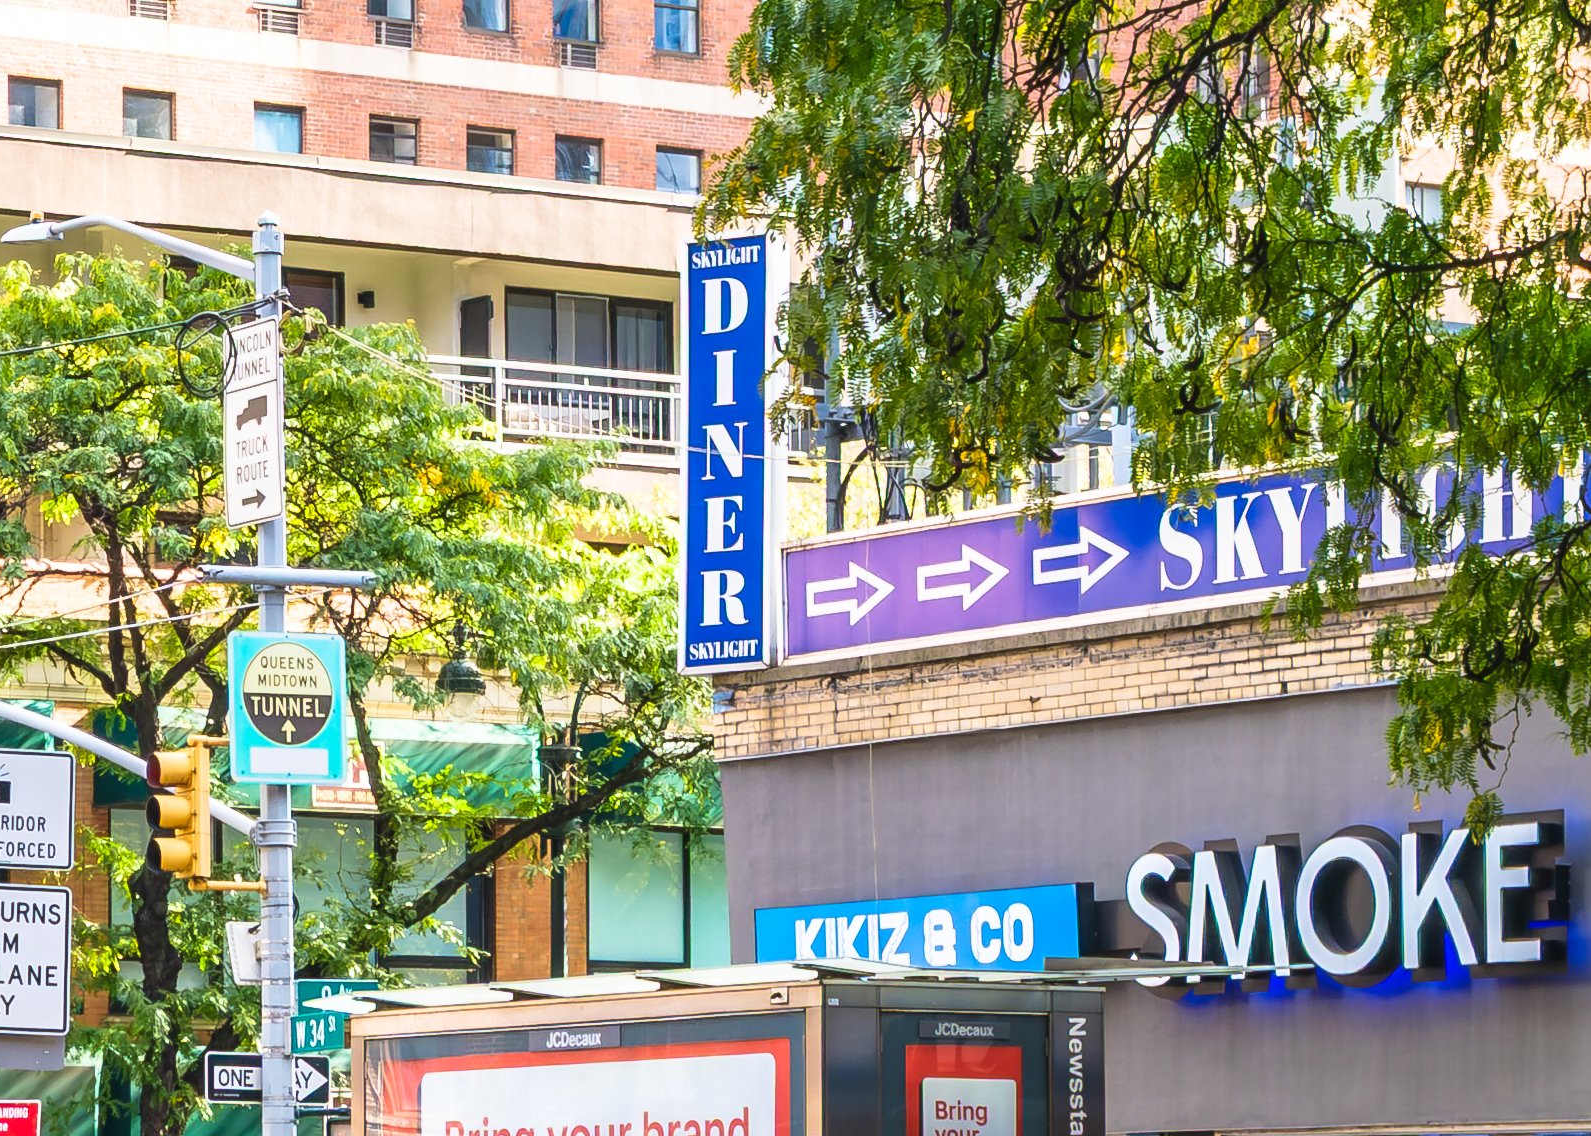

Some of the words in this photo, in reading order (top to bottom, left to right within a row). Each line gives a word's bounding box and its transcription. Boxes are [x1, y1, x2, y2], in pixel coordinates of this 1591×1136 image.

[691, 244, 761, 269] SKYLIGHT
[233, 329, 272, 357] INCOLN
[236, 435, 269, 459] TRUCK
[699, 277, 750, 627] DINER
[237, 460, 269, 485] ROUTE
[689, 639, 759, 661] SKYLIGHT
[260, 656, 314, 670] QUEENS
[258, 674, 318, 688] MIDTOWN
[250, 696, 326, 718] TUNNEL
[1126, 822, 1542, 986] SMOKE
[795, 911, 911, 964] KIKIZ
[923, 908, 957, 967] &
[970, 903, 1034, 964] CO
[296, 1020, 307, 1050] W
[310, 1018, 325, 1048] 34
[546, 1030, 602, 1048] JCDecaux
[935, 1022, 995, 1037] JCDecaux
[218, 1068, 254, 1088] ONE
[295, 1069, 313, 1090] AY
[934, 1100, 988, 1126] Bring
